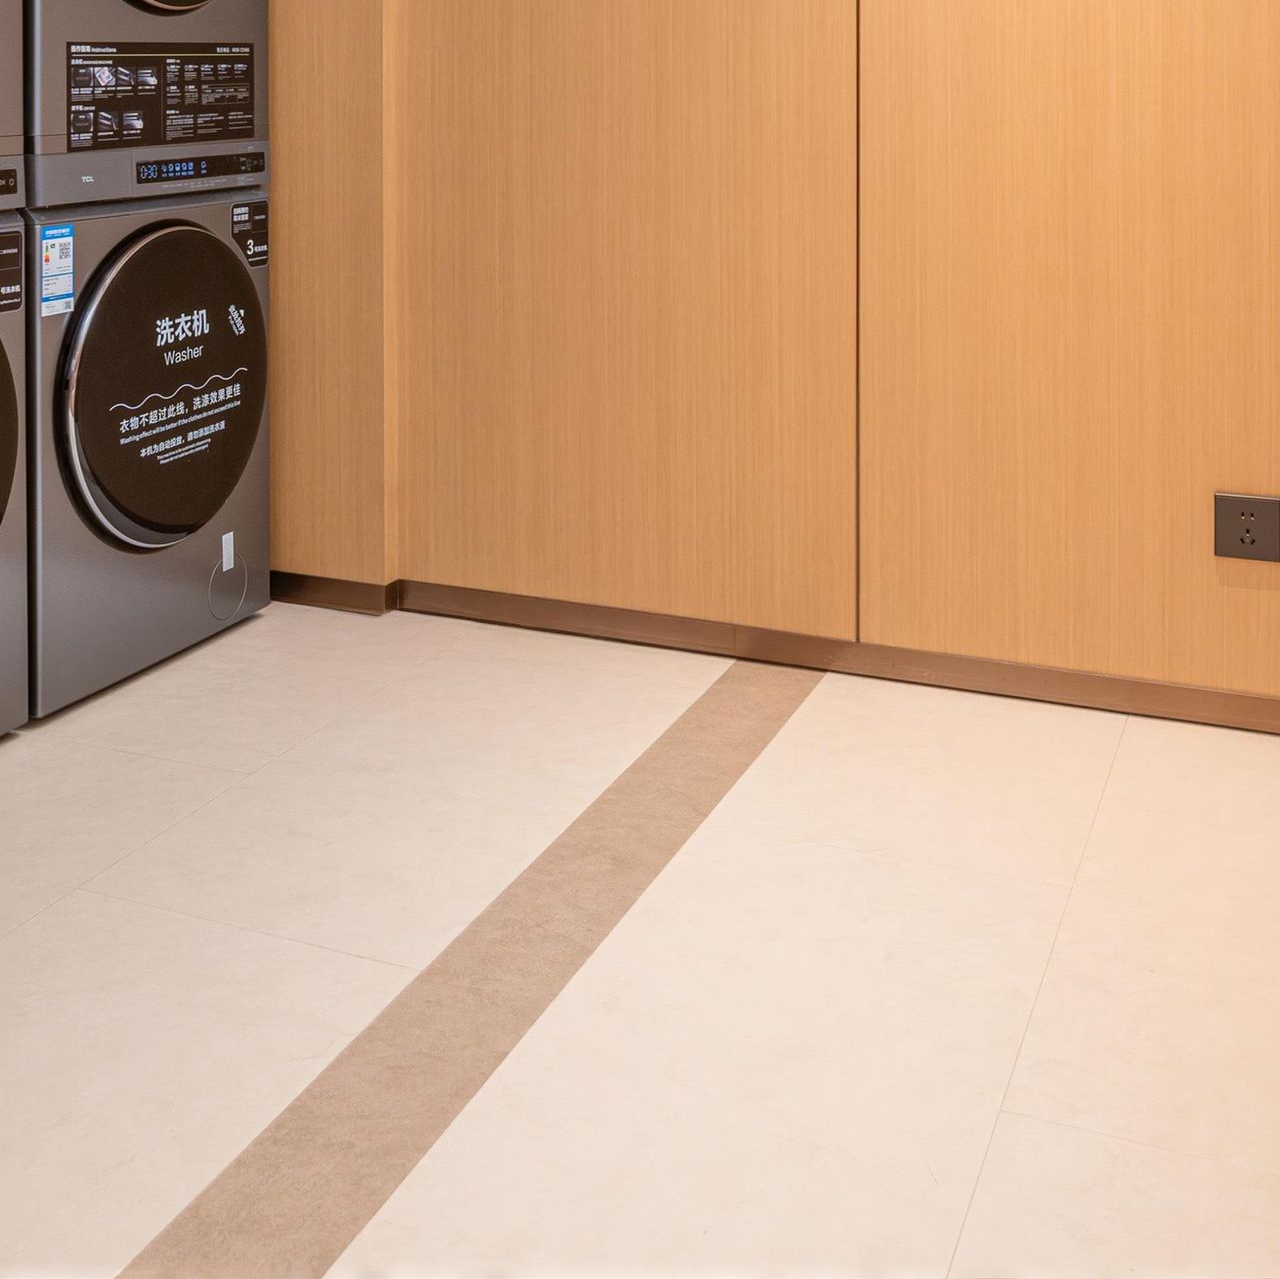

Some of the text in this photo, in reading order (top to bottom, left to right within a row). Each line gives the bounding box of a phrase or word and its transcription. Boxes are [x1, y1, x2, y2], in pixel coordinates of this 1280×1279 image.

[246, 239, 254, 255] 3
[156, 309, 210, 347] 洗衣机
[164, 345, 204, 365] Washer
[120, 383, 240, 433] 衣物不超过此线，洗涤效果更佳
